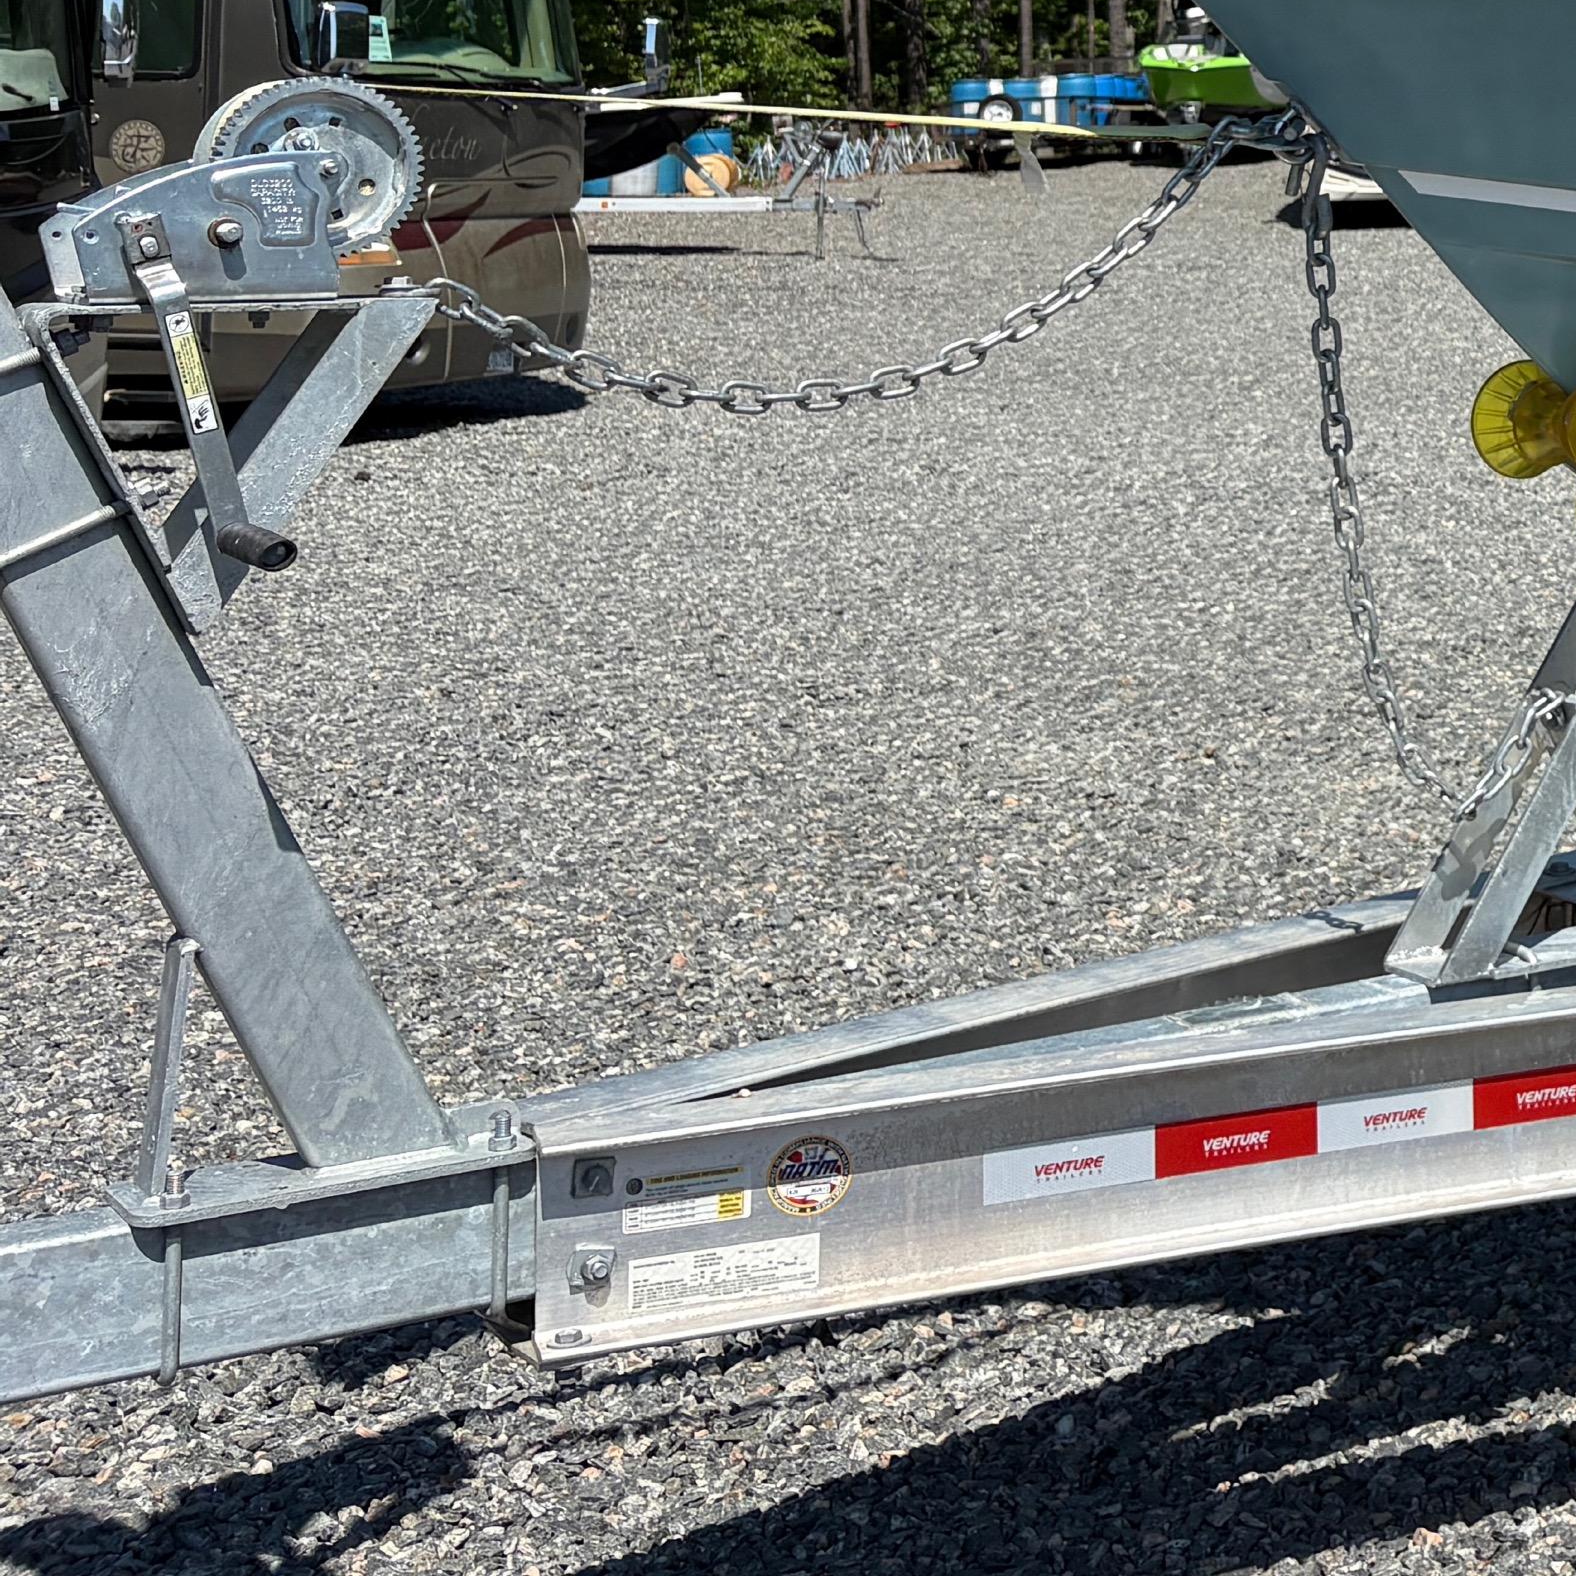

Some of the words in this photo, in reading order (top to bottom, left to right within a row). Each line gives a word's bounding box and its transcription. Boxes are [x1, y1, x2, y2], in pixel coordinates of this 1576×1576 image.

[1363, 1106, 1429, 1127] VENTURE
[1203, 1130, 1271, 1152] VENTURE
[1034, 1155, 1105, 1178] VENTURE
